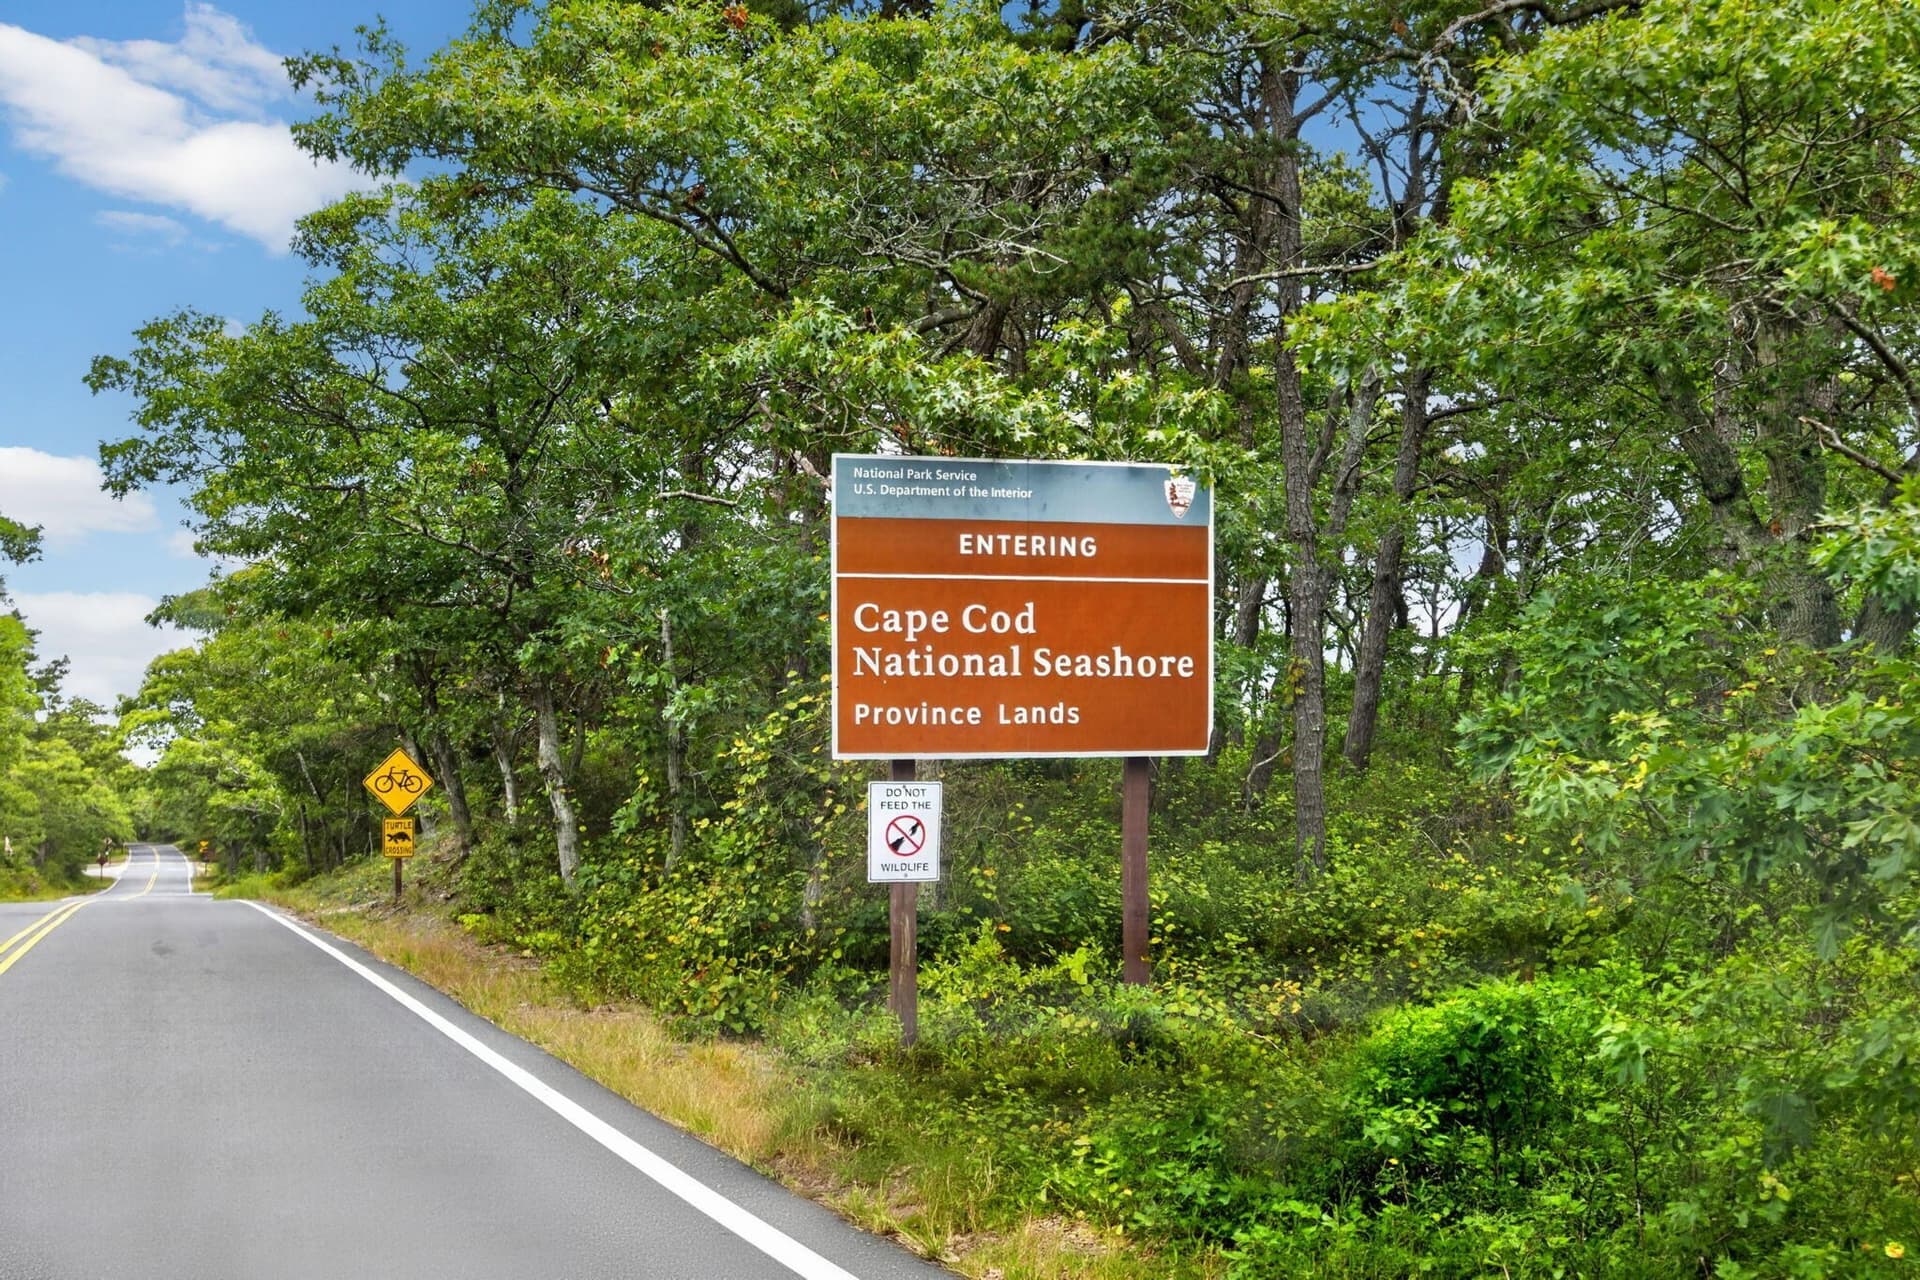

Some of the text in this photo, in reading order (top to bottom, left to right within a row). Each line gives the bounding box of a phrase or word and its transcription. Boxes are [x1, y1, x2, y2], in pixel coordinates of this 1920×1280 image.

[853, 467, 977, 481] National Park Service
[853, 484, 1033, 500] U.S. Department of the Interior
[959, 533, 1097, 557] ENTERING
[853, 602, 1037, 642] Cape Cod
[853, 645, 1194, 678] National Seashore
[854, 702, 1080, 725] Province Lands
[886, 788, 927, 797] DO NOT
[880, 801, 931, 810] FEED THE
[386, 821, 412, 829] TURTLE
[385, 846, 412, 854] CROSSING
[880, 863, 929, 872] WILDLIFE
